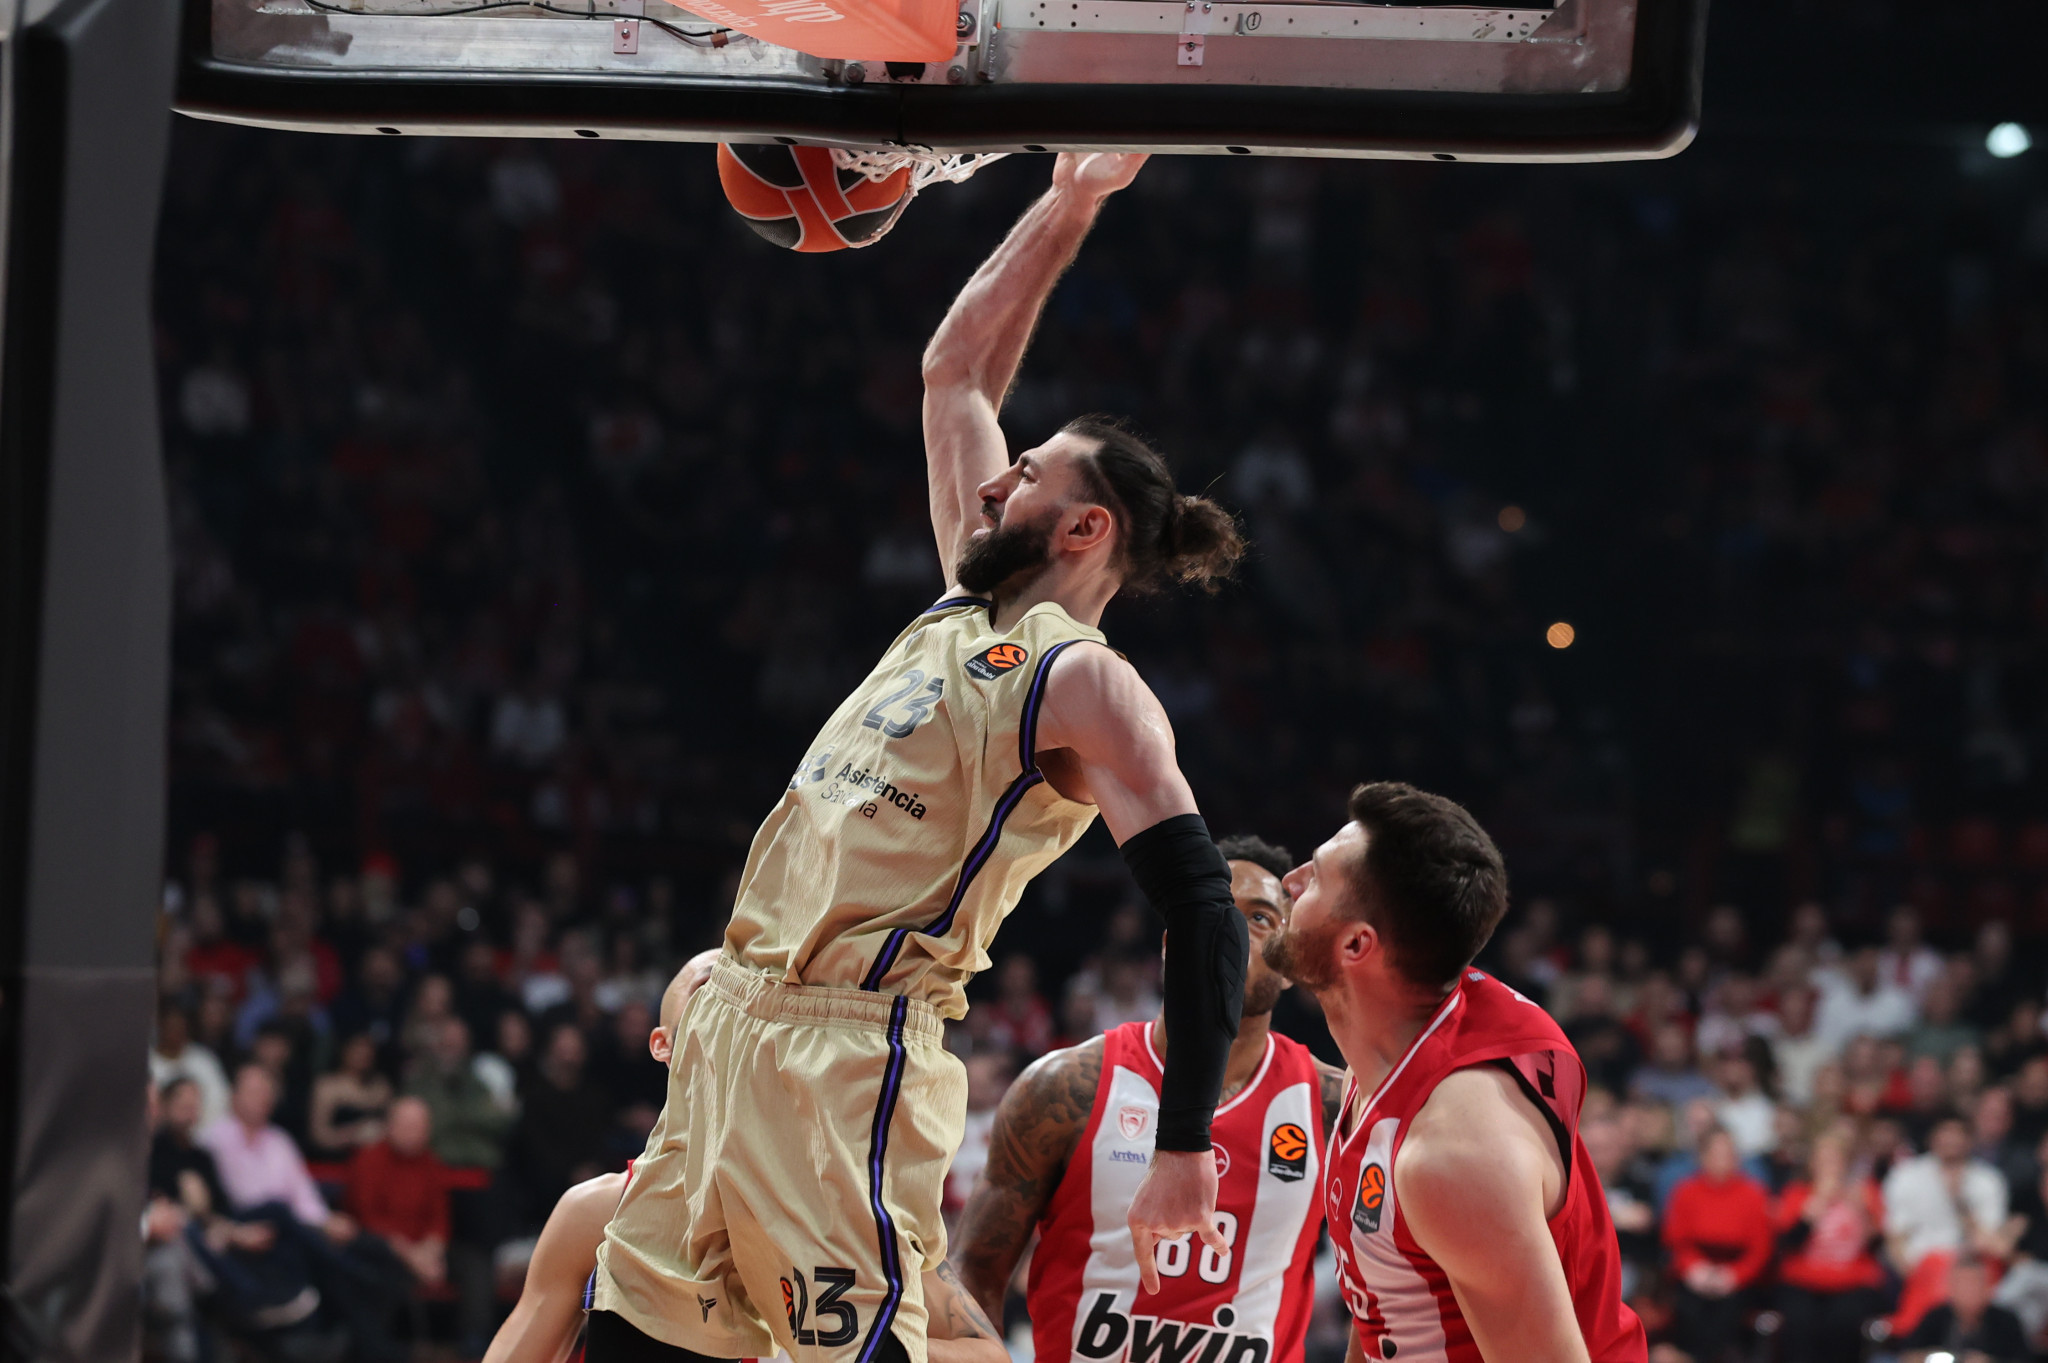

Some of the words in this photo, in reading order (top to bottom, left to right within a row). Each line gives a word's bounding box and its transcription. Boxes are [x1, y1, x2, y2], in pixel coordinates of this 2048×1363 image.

[863, 670, 945, 739] 23
[835, 762, 927, 820] Asistència
[1075, 1292, 1271, 1363] bwin
